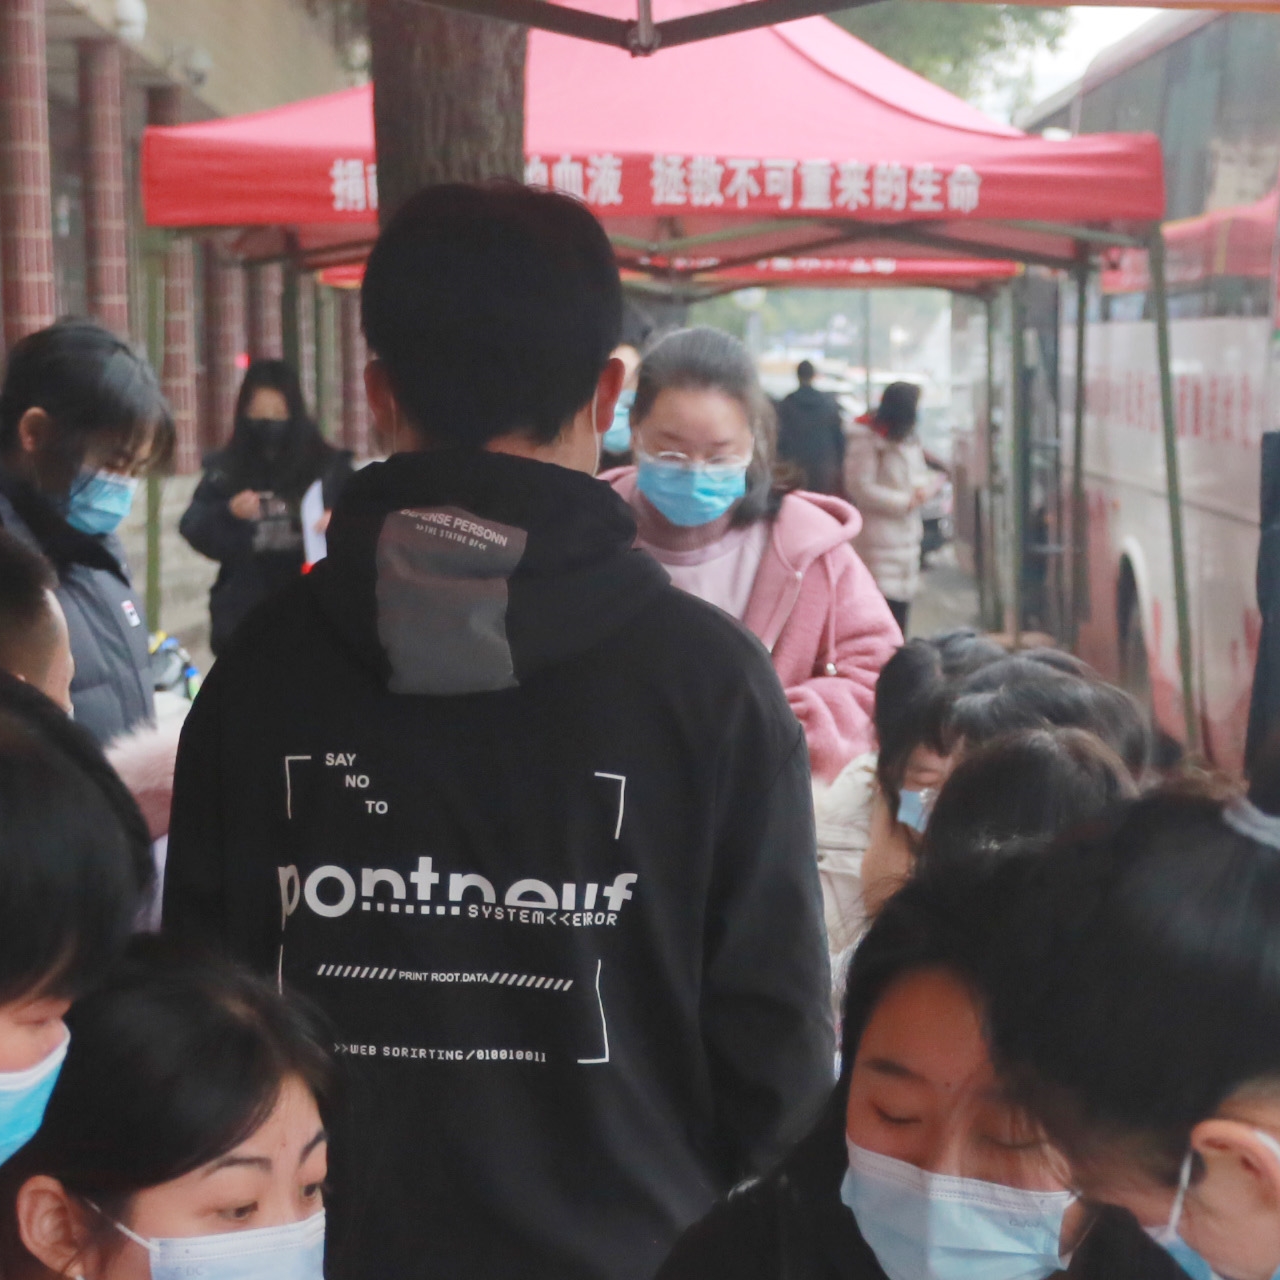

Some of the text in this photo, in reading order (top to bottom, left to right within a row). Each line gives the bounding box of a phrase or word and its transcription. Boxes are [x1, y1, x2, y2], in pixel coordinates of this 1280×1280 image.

[649, 154, 983, 213] 拯救不可重来的生命
[325, 753, 357, 767] SAY
[345, 774, 370, 789] NO
[365, 800, 389, 815] TO
[398, 971, 428, 981] PRINT
